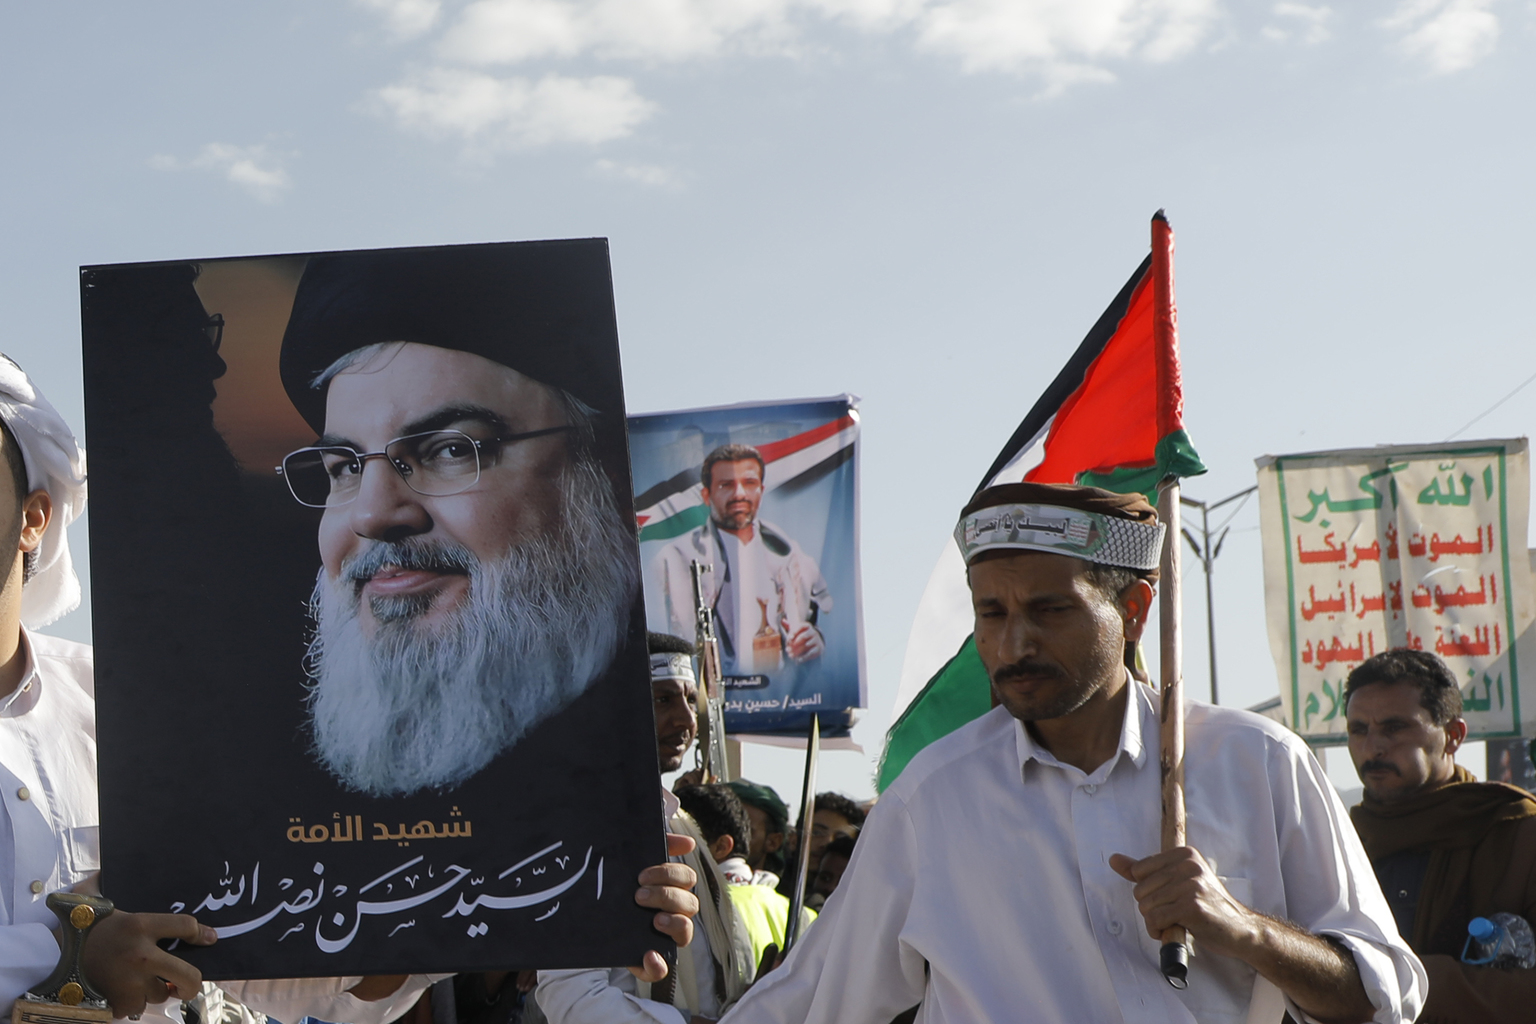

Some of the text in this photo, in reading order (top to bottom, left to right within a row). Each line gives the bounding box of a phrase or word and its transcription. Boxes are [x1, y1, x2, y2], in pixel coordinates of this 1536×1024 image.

[1292, 457, 1494, 528] الله أكبر
[1297, 521, 1494, 569] الموت لأمريكا
[1301, 573, 1498, 621] الموت لإسرائيل
[1435, 623, 1502, 657] اللعنة
[745, 699, 780, 714] حسين
[1462, 668, 1505, 713] الن
[286, 805, 473, 847] شهيد الأمة
